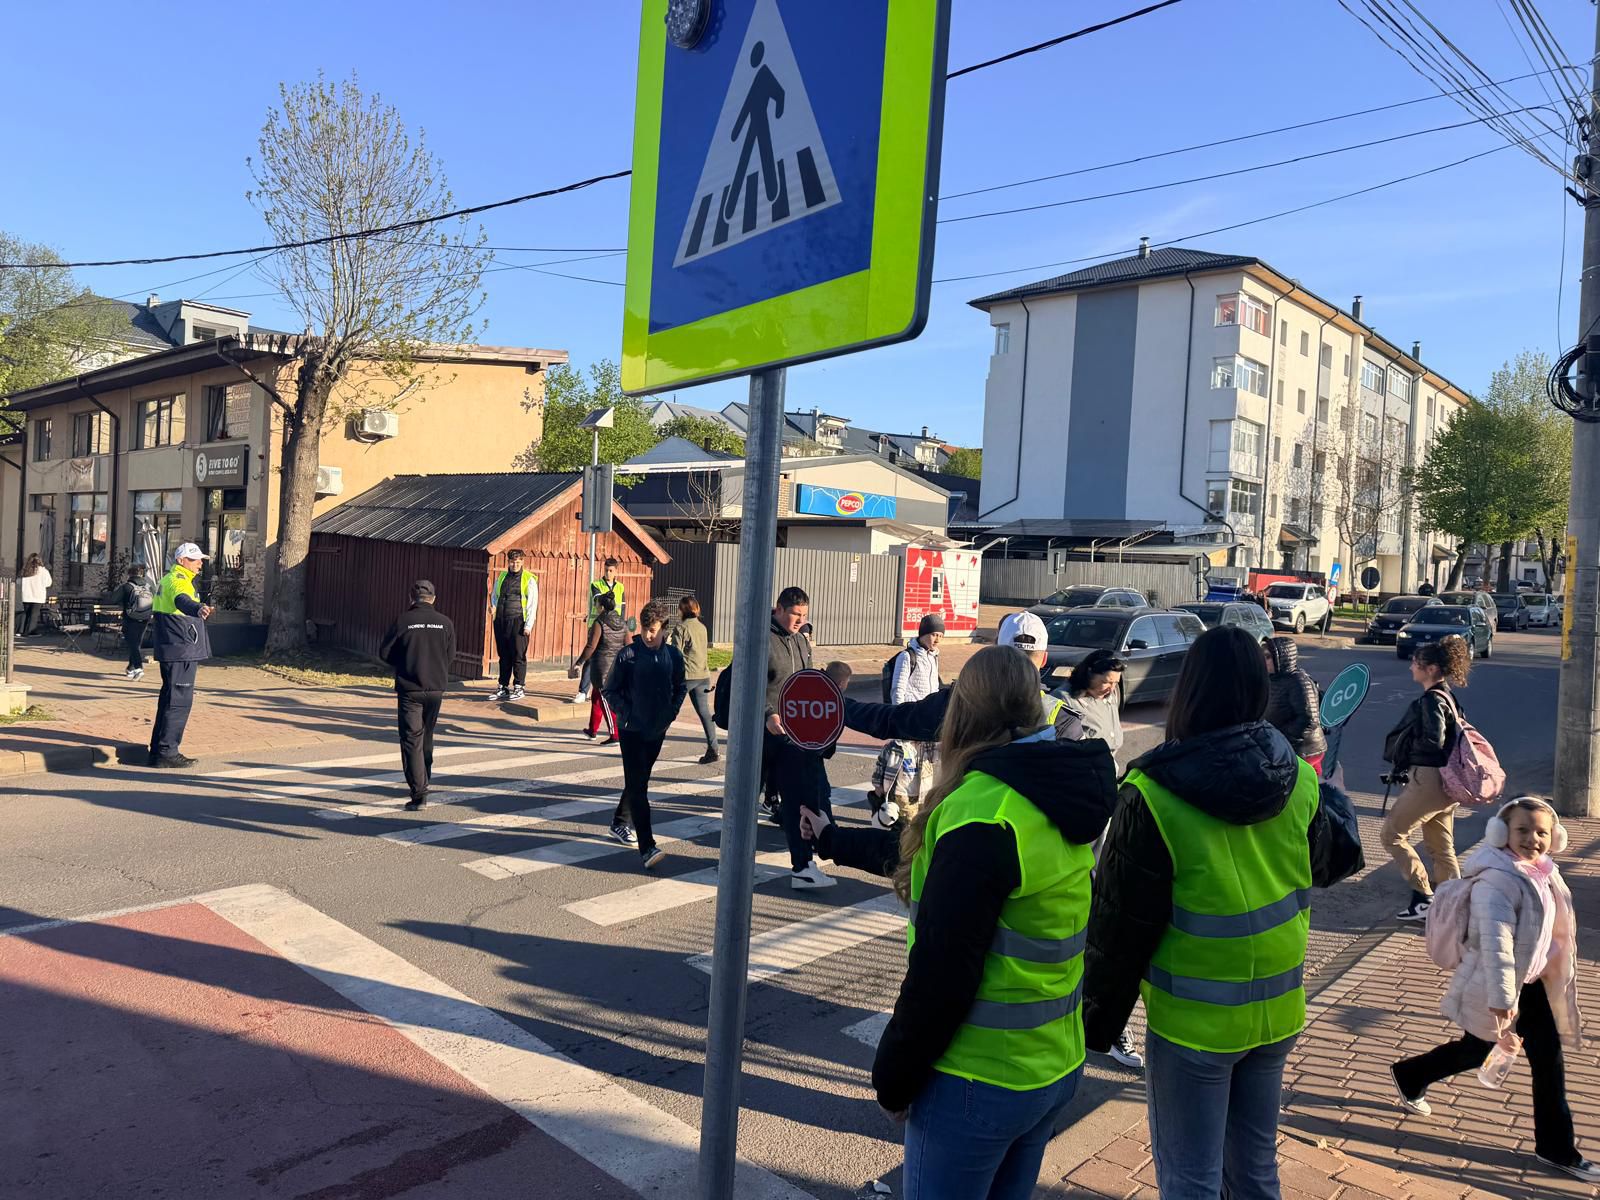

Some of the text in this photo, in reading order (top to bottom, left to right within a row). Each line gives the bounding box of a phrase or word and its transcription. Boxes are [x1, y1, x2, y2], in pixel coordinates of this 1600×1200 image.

[208, 457, 239, 469] FIVE TO GO
[840, 499, 861, 508] PEPCO
[1331, 683, 1357, 707] GO
[785, 700, 837, 719] STOP
